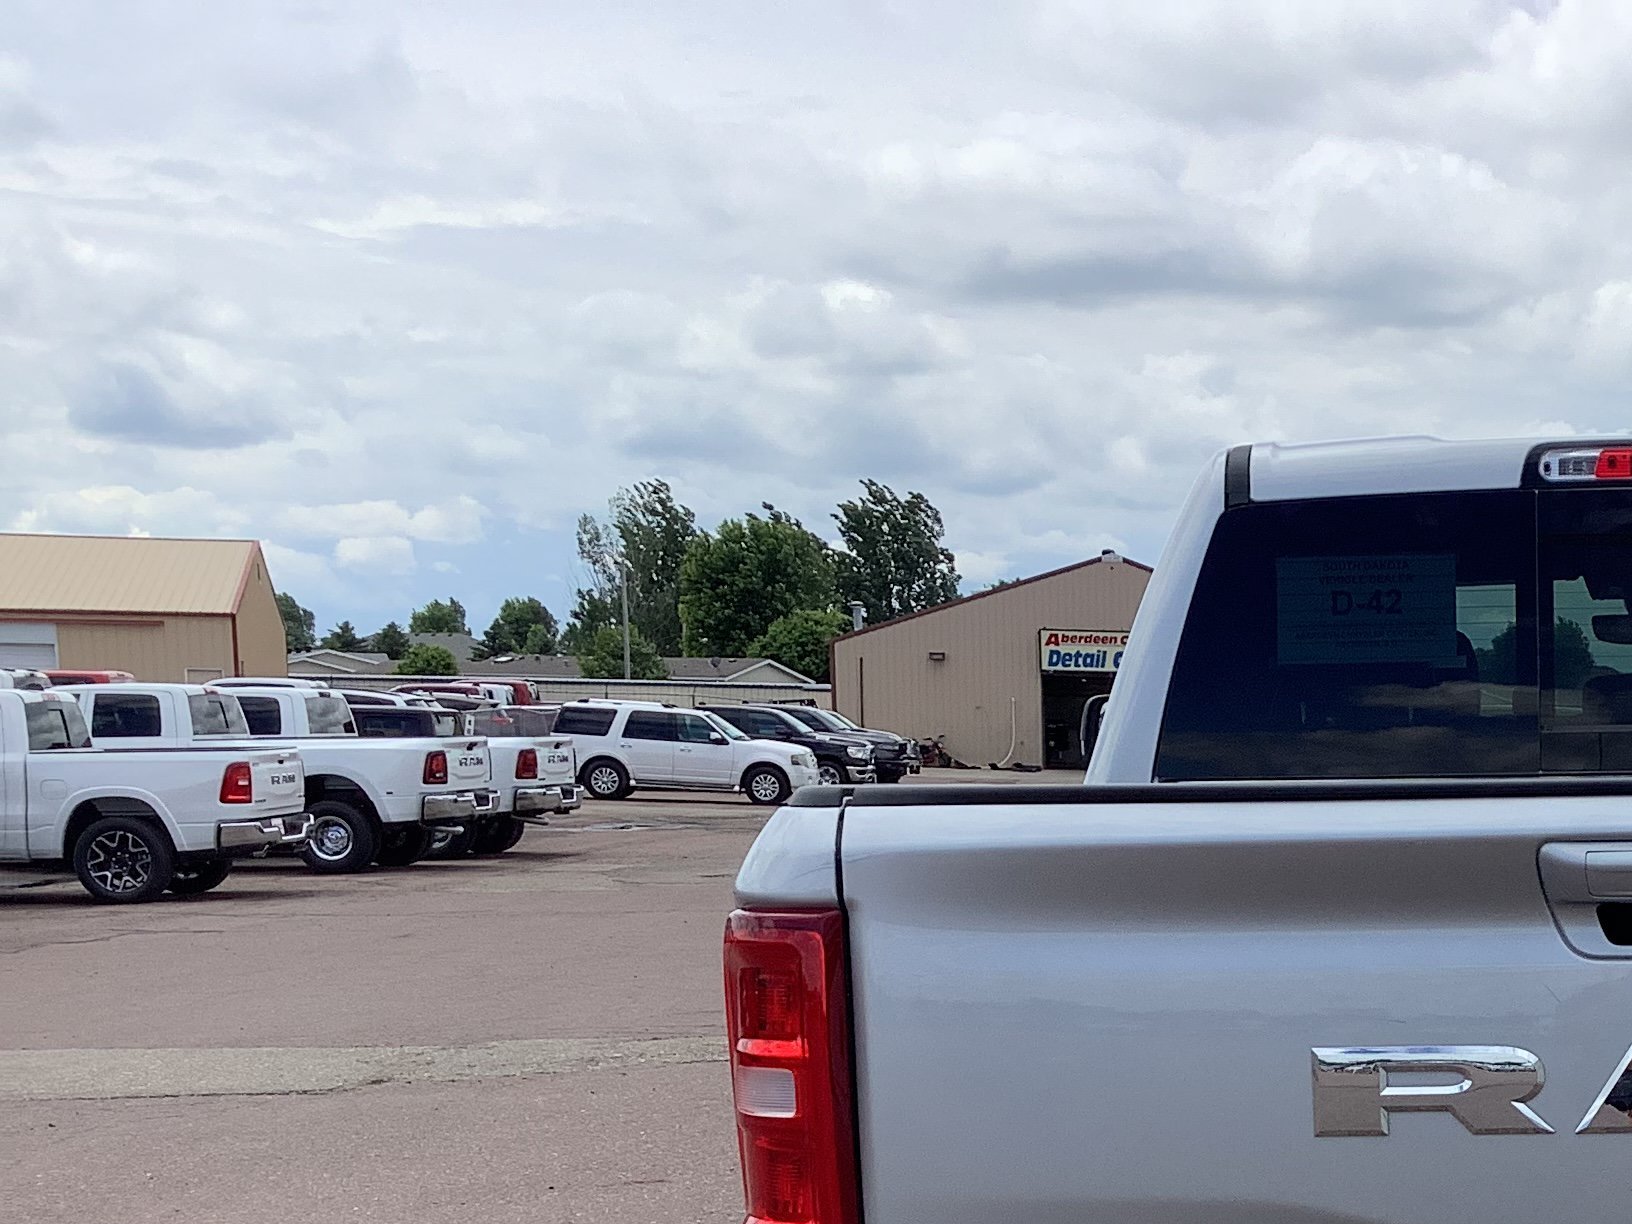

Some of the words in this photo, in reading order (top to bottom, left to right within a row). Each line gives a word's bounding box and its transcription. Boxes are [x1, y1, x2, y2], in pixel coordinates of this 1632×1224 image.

[1322, 561, 1361, 572] SOUTH
[1364, 559, 1410, 571] DAKOTA
[1330, 588, 1403, 616] D-42
[1044, 633, 1118, 646] Aberdeen
[1047, 649, 1108, 668] Detail
[458, 756, 484, 767] RAM
[547, 754, 569, 764] RAM
[270, 773, 296, 785] RAM
